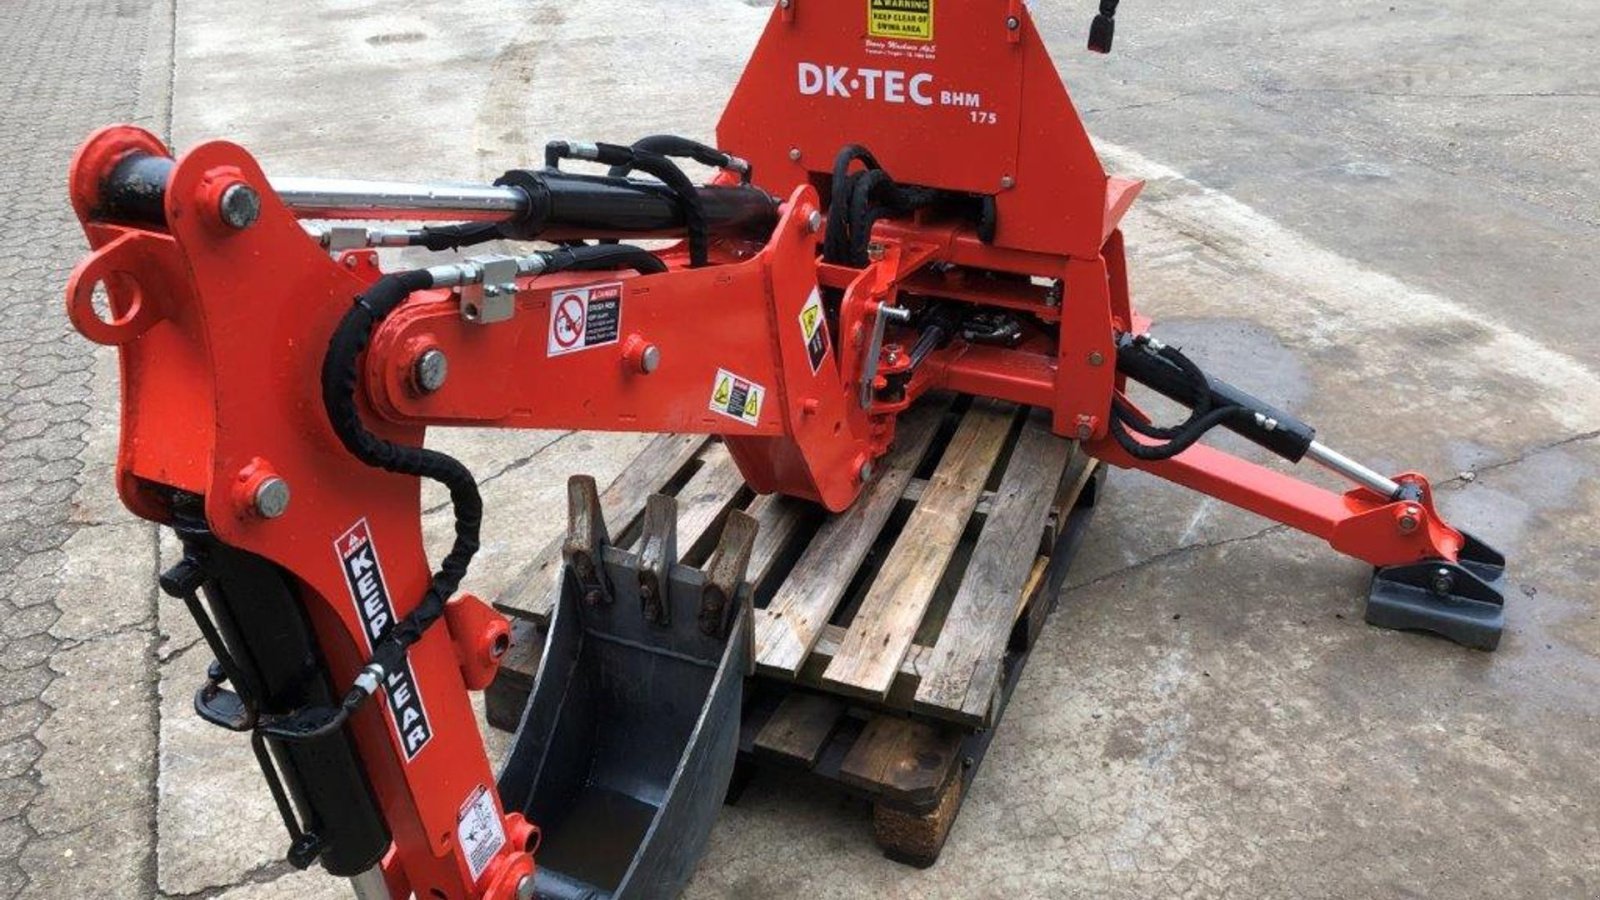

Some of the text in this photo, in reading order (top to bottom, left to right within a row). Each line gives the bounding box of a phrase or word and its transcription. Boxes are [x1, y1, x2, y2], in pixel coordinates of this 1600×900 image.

[884, 0, 928, 9] WARNING
[894, 14, 916, 22] CLEAR
[902, 24, 921, 32] AREA
[940, 91, 980, 107] BHM
[969, 111, 997, 124] 175
[350, 546, 388, 639] KEEP
[387, 671, 426, 751] LEAR
